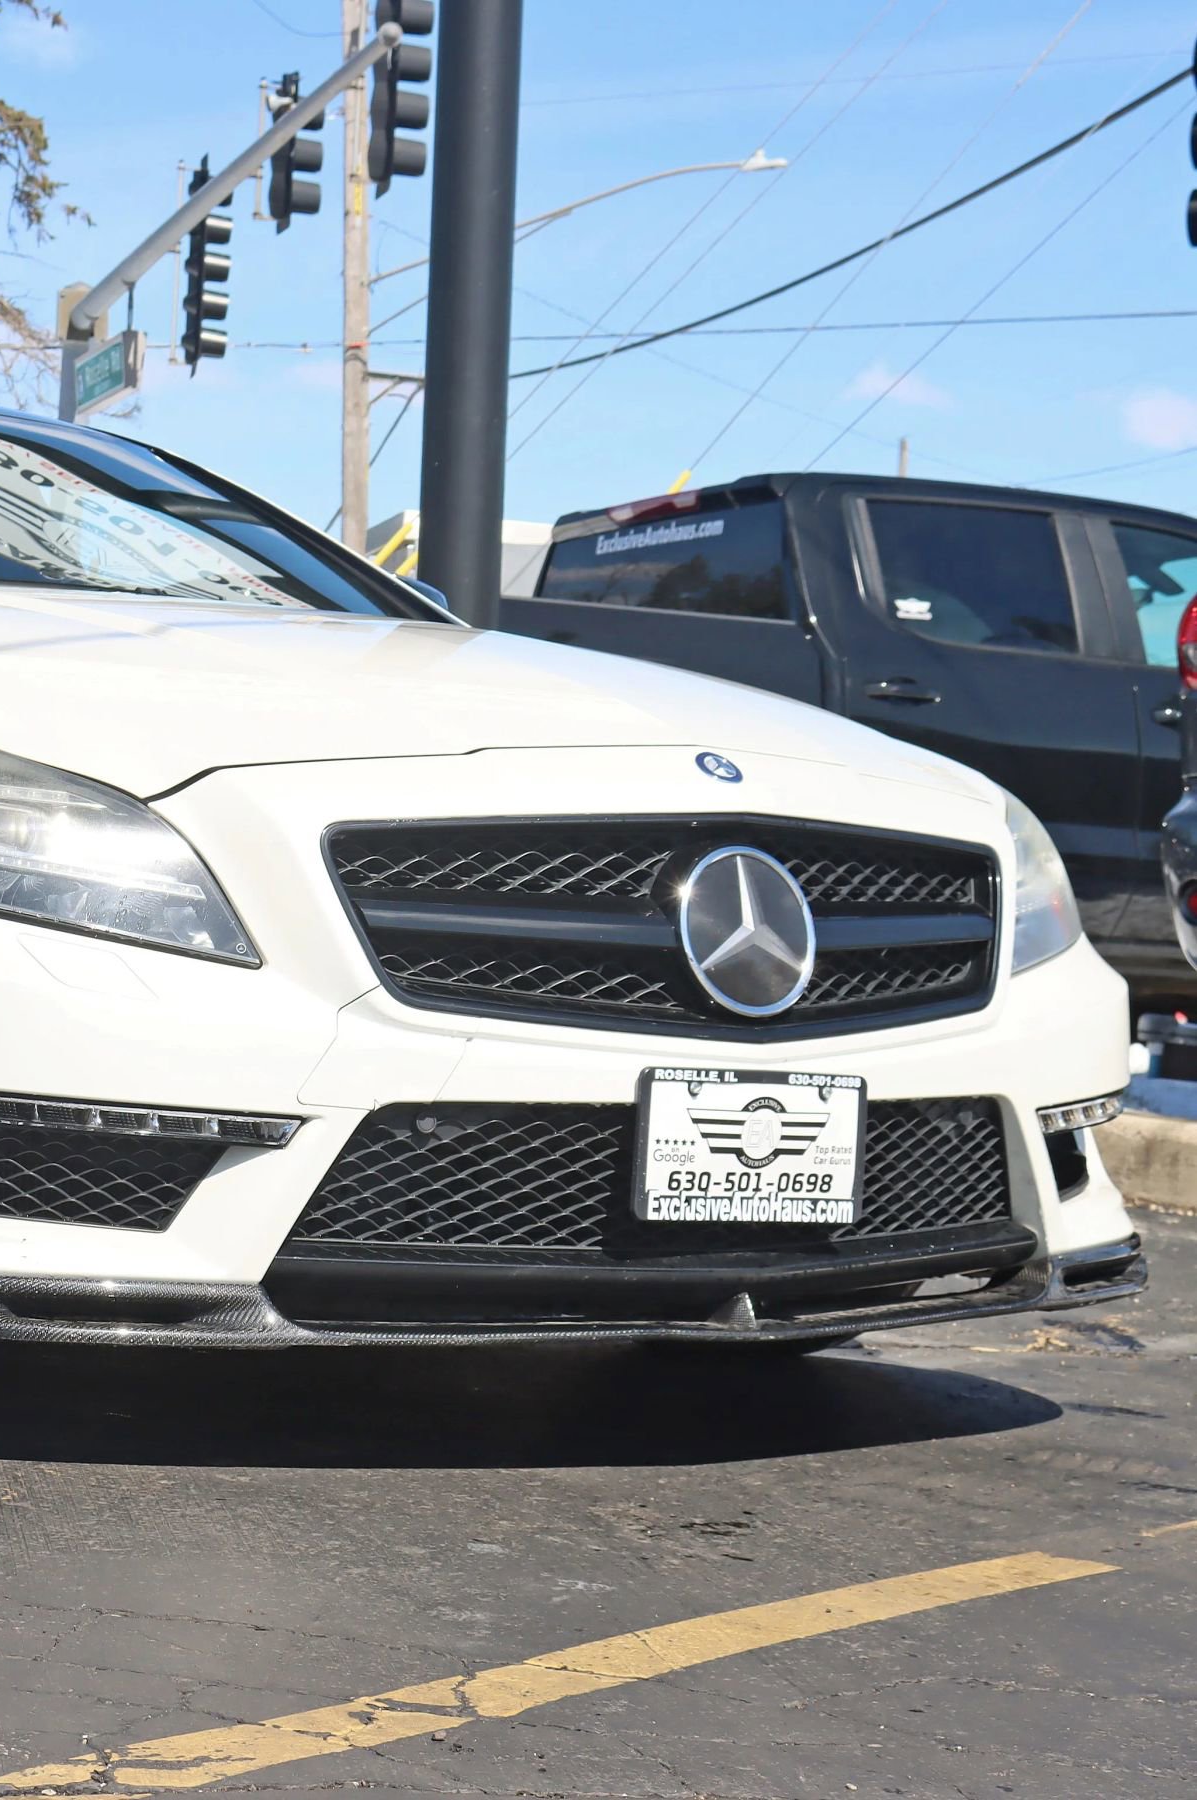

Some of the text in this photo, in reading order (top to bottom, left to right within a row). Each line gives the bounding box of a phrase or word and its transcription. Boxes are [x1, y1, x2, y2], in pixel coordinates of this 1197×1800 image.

[655, 1068, 738, 1083] ROSELLE, IL
[788, 1074, 862, 1088] 630-501-0698
[653, 1148, 696, 1166] Google
[815, 1145, 852, 1155] Top Rated
[813, 1156, 827, 1165] Car
[667, 1170, 834, 1193] 630-501-0698
[647, 1189, 853, 1224] ExclusiveAutoHaus.com
